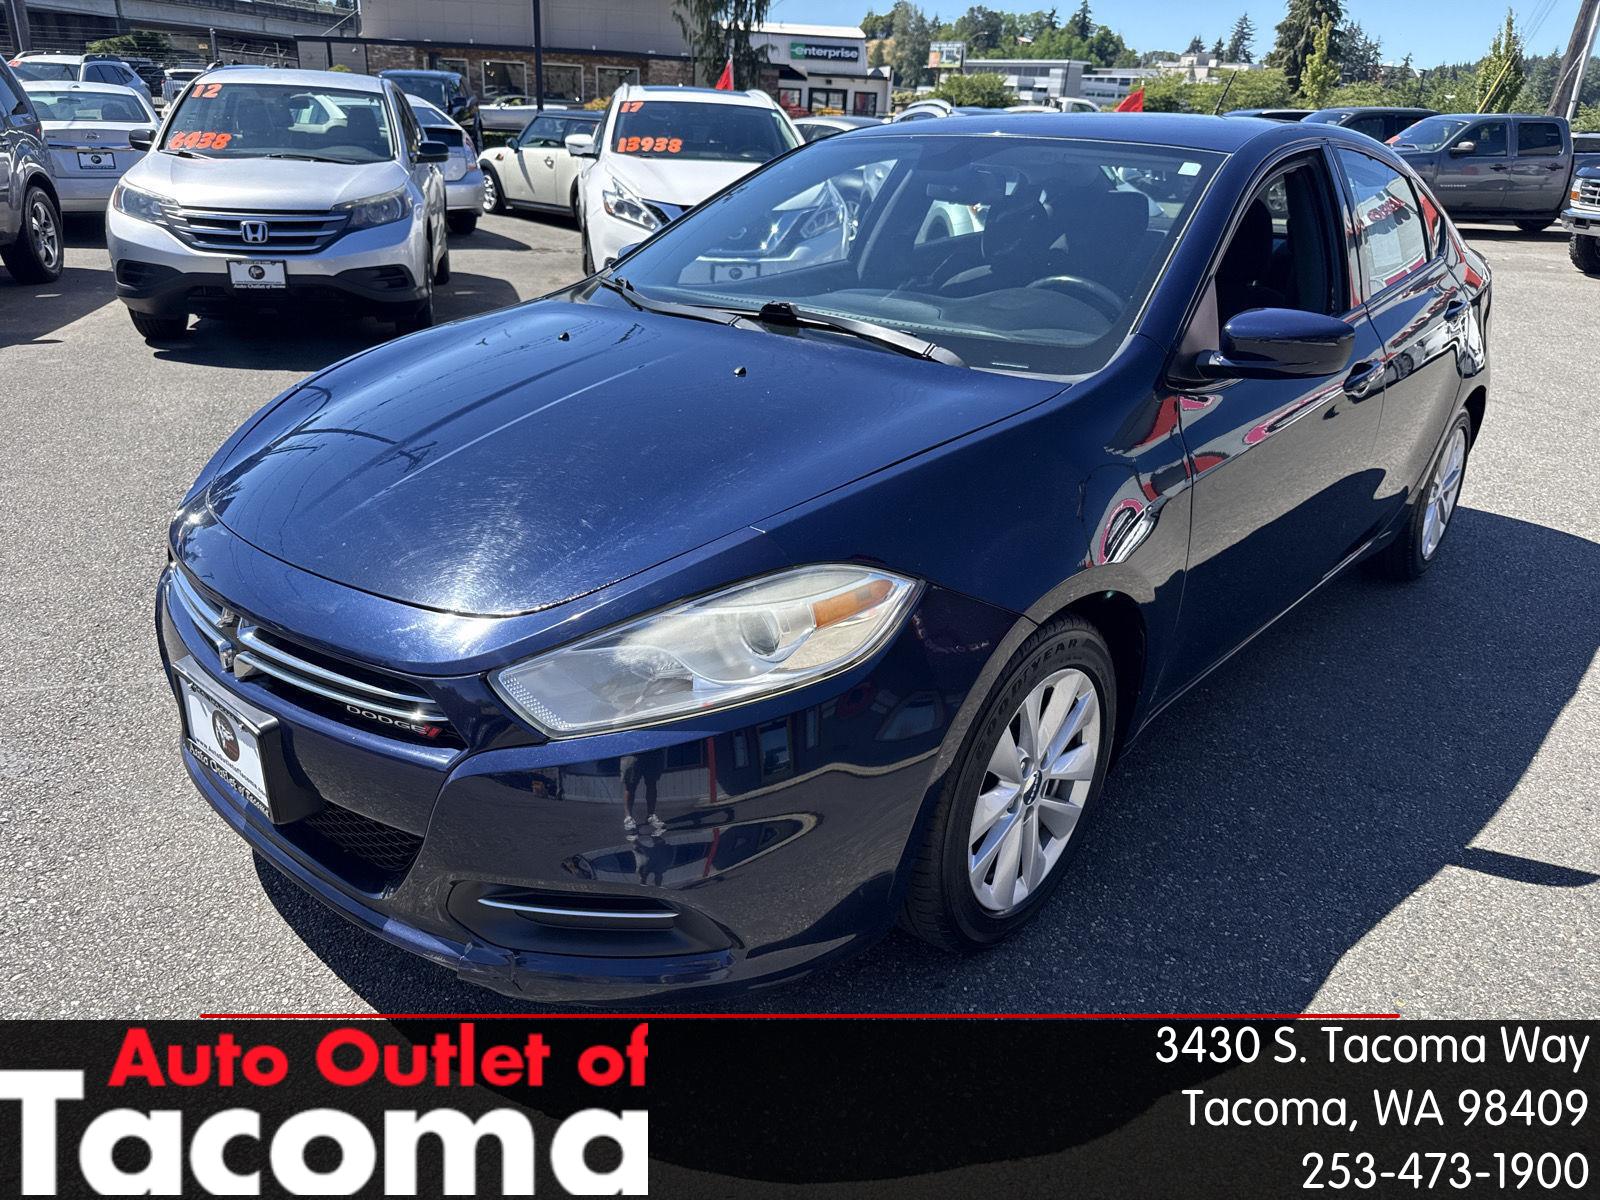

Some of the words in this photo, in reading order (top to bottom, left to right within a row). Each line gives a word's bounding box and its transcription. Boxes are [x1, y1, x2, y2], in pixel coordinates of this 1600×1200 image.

[794, 44, 859, 60] enterprise
[191, 83, 223, 99] 12
[620, 101, 645, 113] 17
[617, 136, 683, 153] 13938
[346, 704, 427, 736] DODGE
[189, 742, 209, 766] Auto
[209, 758, 238, 792] Outlet
